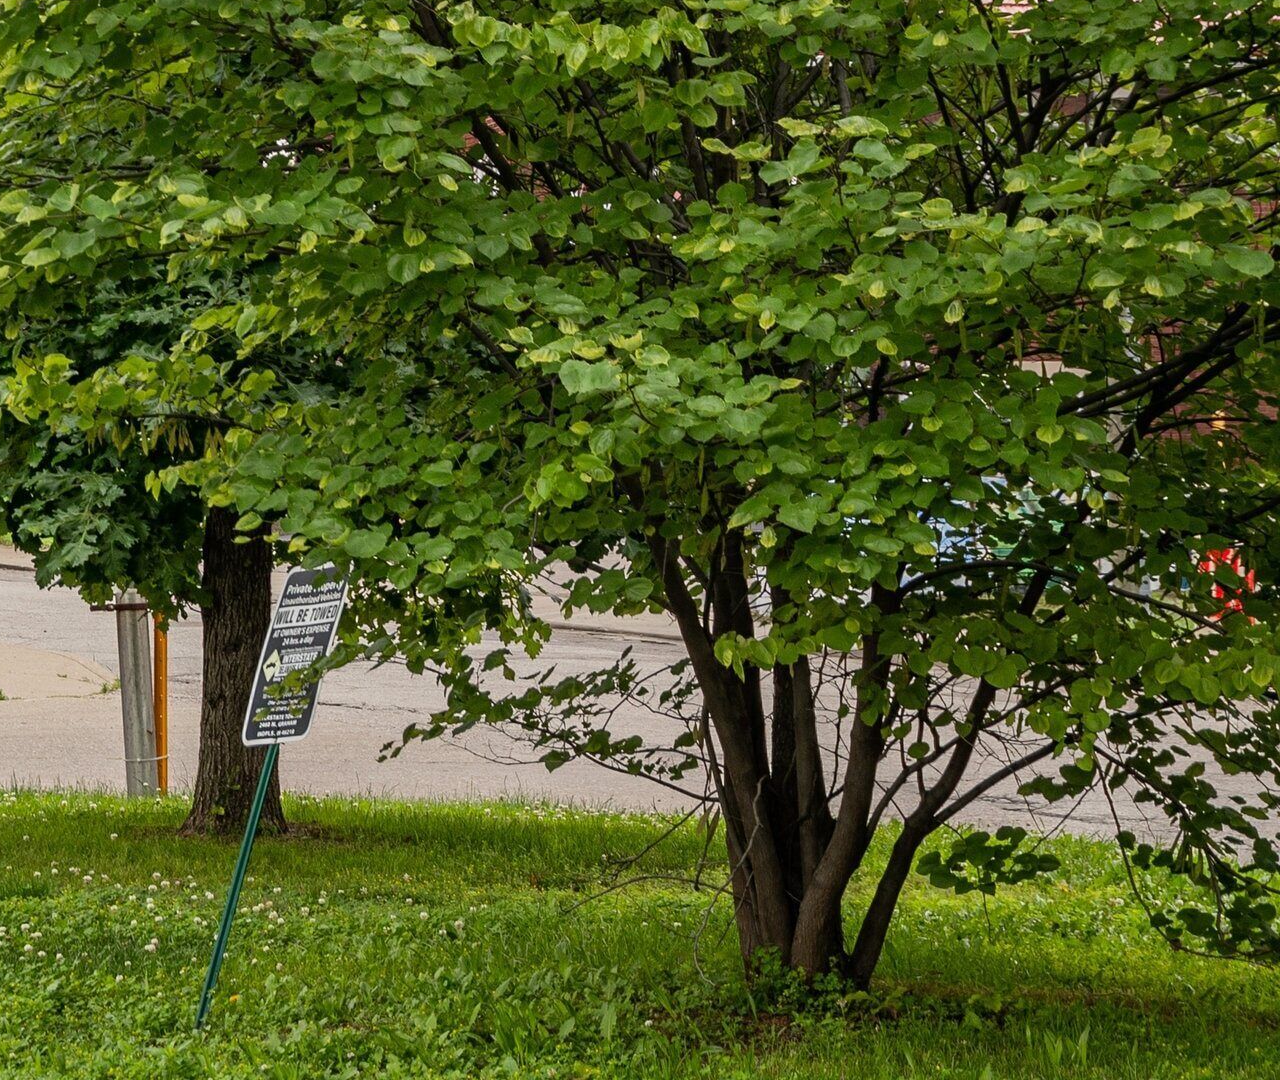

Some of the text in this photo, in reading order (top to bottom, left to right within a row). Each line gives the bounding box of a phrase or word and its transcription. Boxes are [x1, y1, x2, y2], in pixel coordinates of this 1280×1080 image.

[286, 584, 313, 595] Private
[275, 604, 338, 625] WILL BE TOWED
